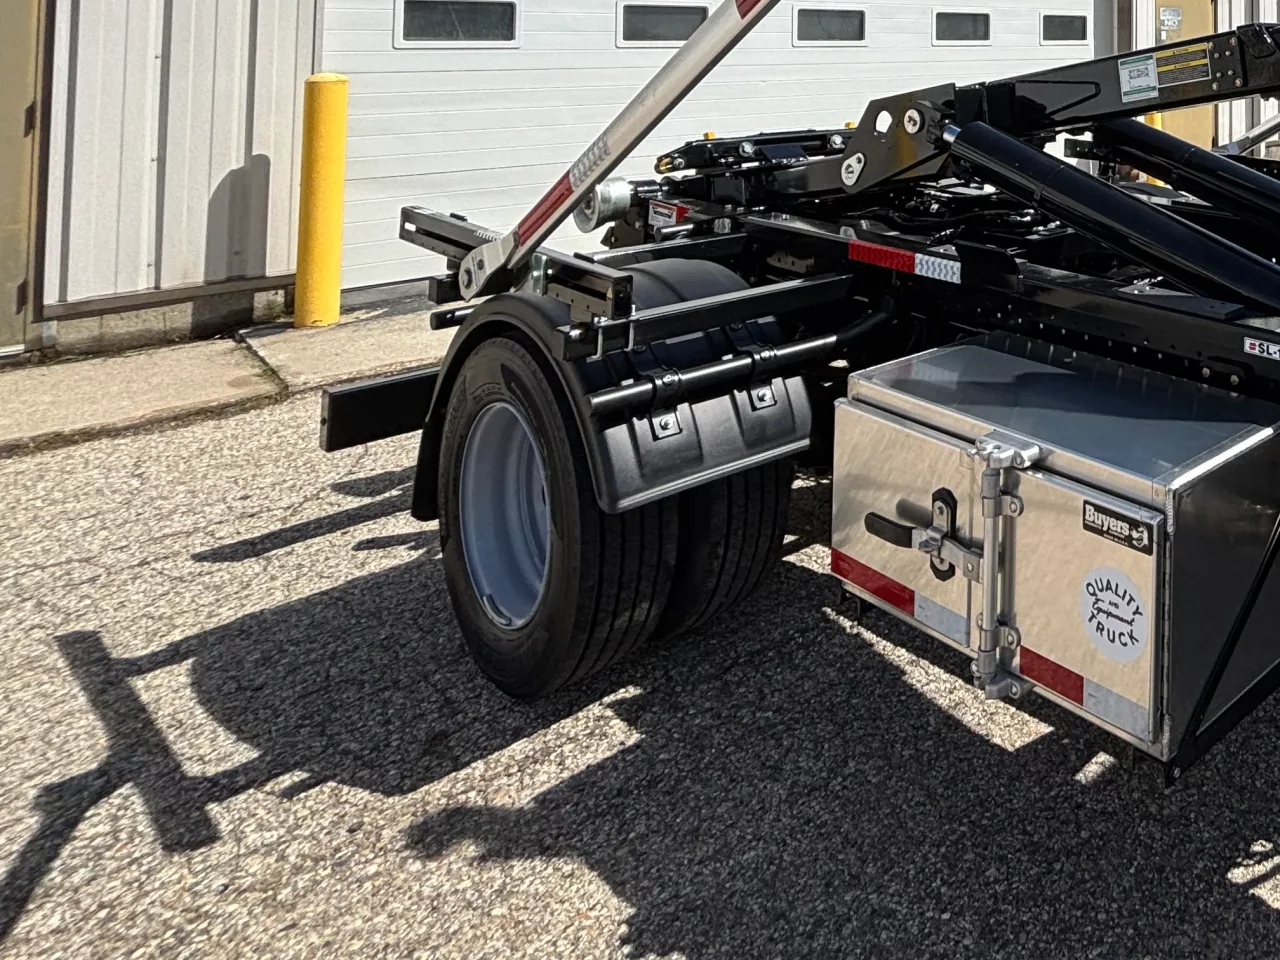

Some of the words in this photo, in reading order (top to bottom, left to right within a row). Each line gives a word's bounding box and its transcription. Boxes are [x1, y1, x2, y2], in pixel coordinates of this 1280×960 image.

[1164, 19, 1179, 27] NO
[1085, 503, 1130, 536] Buyers
[1085, 576, 1143, 617] QUALITY
[1087, 610, 1140, 647] TRUCK
